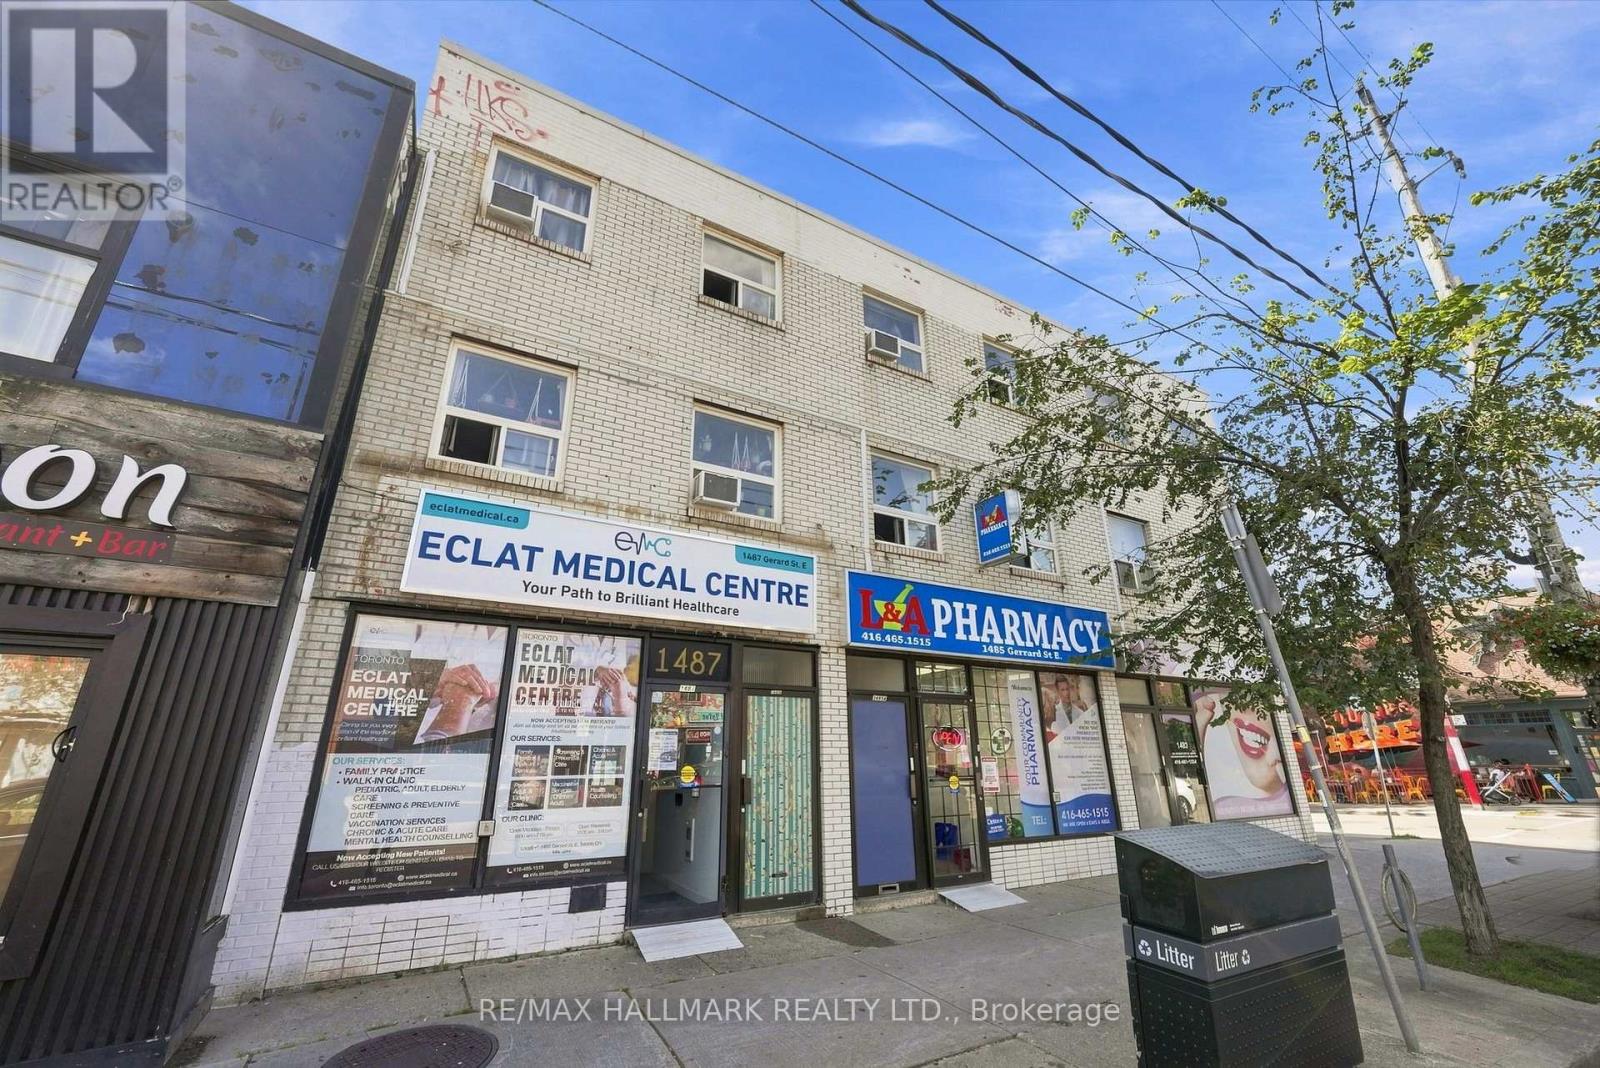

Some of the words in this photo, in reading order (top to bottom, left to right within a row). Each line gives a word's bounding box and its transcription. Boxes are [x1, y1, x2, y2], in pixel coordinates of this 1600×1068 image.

[430, 502, 519, 524] eclatmedical.ca
[96, 526, 168, 558] Bar
[743, 551, 761, 562] 1487
[763, 555, 790, 567] Gerard
[802, 561, 807, 569] E
[418, 530, 544, 572] ECLAT
[552, 550, 696, 593] MEDICAL
[705, 571, 809, 607] CENTRE
[522, 580, 557, 596] Your
[561, 585, 593, 601] Path
[598, 590, 611, 602] to
[615, 591, 669, 609] Brilliant
[673, 599, 740, 616] Healthcare
[931, 598, 1102, 654] PHARMACY
[861, 631, 931, 647] 416.465.1515
[521, 643, 575, 664] ECLAT
[982, 645, 1005, 655] 1485
[1007, 647, 1042, 659] Gerrard
[354, 655, 405, 665] TORONTO
[655, 647, 722, 676] 1487
[350, 669, 411, 684] ECLAT
[518, 664, 597, 686] MEDICAL
[347, 686, 429, 701] MEDICAL
[515, 686, 582, 707] CENTRE
[343, 702, 418, 717] CENTRE
[1021, 697, 1040, 785] PHARMACY
[333, 757, 355, 765] OUR
[386, 776, 416, 784] CLINIC
[1023, 760, 1031, 786] YOUR
[431, 784, 466, 792] ELDERLY
[352, 802, 401, 810] SCREENING
[411, 800, 460, 808] PREVENTIVE
[353, 794, 378, 802] CARE
[350, 811, 375, 819] CARE
[1061, 807, 1109, 820] 416-465-1515
[348, 818, 404, 828] VACCINATION
[406, 817, 446, 825] SERVICES
[344, 837, 380, 846] MENTAL
[381, 835, 415, 844] HEALTH
[416, 832, 473, 841] COUNSELLING
[346, 828, 387, 837] CHRONIC
[387, 827, 394, 835] &
[395, 826, 424, 834] ACUTE
[337, 854, 355, 862] Now
[356, 852, 395, 862] Accepting
[395, 850, 413, 859] New
[413, 848, 446, 857] Patients!
[1156, 939, 1194, 970] Litter
[1215, 949, 1238, 972] Litter
